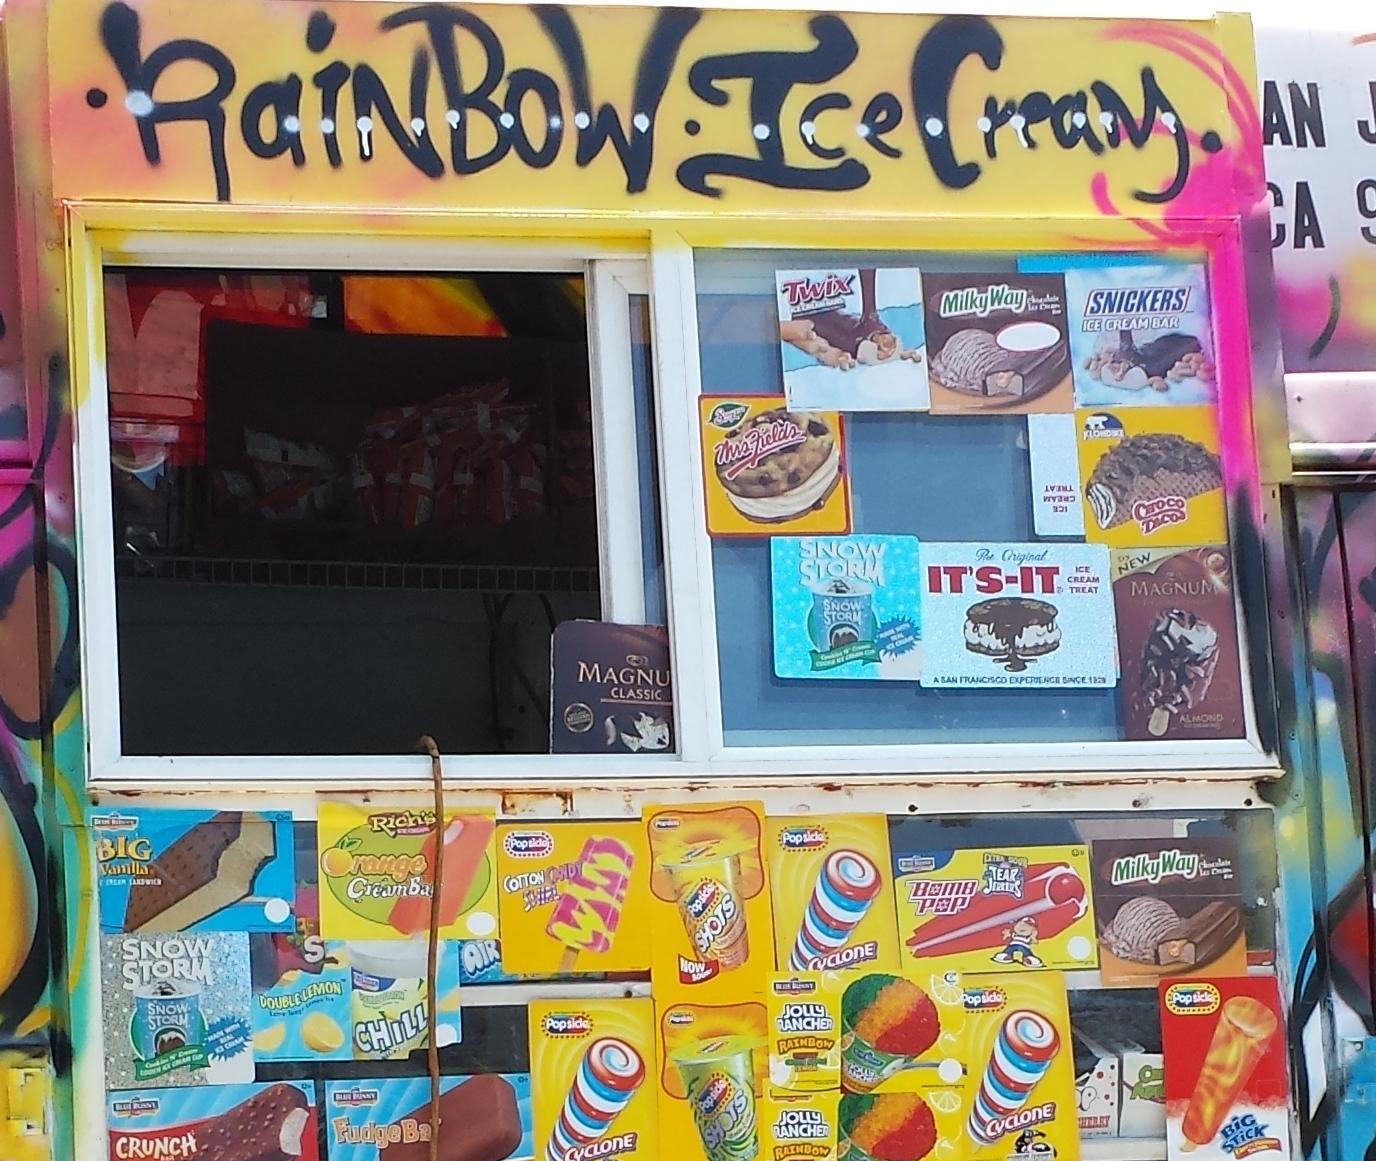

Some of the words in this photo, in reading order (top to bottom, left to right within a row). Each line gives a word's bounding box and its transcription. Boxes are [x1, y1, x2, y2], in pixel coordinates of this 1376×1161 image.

[676, 14, 904, 199] Ice
[1087, 288, 1190, 316] SNICKERS
[1082, 320, 1102, 332] ICE
[1105, 319, 1149, 331] CREAM
[1151, 317, 1180, 329] BAR
[1133, 497, 1186, 520] CHOCO
[798, 540, 888, 560] SNOW
[1001, 548, 1048, 566] Original
[1118, 551, 1151, 575] NEW
[798, 559, 888, 589] STORM
[927, 566, 1060, 594] IT'S-IT
[1131, 580, 1219, 597] MAGNUM
[823, 600, 862, 612] SNOW
[823, 611, 862, 625] STORM
[610, 687, 663, 701] CLASSIC
[1179, 713, 1224, 724] ALMOND
[369, 811, 437, 838] Rich's
[509, 836, 550, 852] Popsicle
[782, 831, 824, 846] Popsicle
[96, 837, 152, 862] BIG
[101, 860, 149, 876] Vanilla
[503, 871, 545, 893] COTTON
[545, 861, 585, 881] CANDY
[990, 865, 1018, 883] TEAR
[346, 874, 442, 899] CreamBa
[909, 880, 978, 898] BOMB
[917, 896, 970, 916] POP
[694, 893, 738, 953] SHOTS
[121, 938, 215, 960] SNOW
[808, 942, 875, 971] CYCLONE
[121, 957, 215, 990] STORM
[680, 957, 706, 974] NOW
[258, 992, 302, 1011] DOUBLE
[302, 981, 343, 1005] LEMON
[962, 991, 1003, 1006] Popsicle
[1173, 991, 1214, 1007] Popsicle
[148, 1002, 189, 1016] SNOW
[784, 1004, 825, 1019] JOLLY
[148, 1014, 189, 1031] STORM
[545, 1015, 590, 1031] Popsicle
[777, 1017, 833, 1032] RANCHER
[777, 1036, 835, 1054] RAINBOW
[703, 1090, 748, 1150] SHOTS
[780, 1111, 822, 1126] JOLLY
[985, 1103, 1055, 1138] CYCLONE
[774, 1124, 829, 1138] RANCHER
[115, 1131, 198, 1160] CRUNCH
[774, 1143, 831, 1161] RAINBOW
